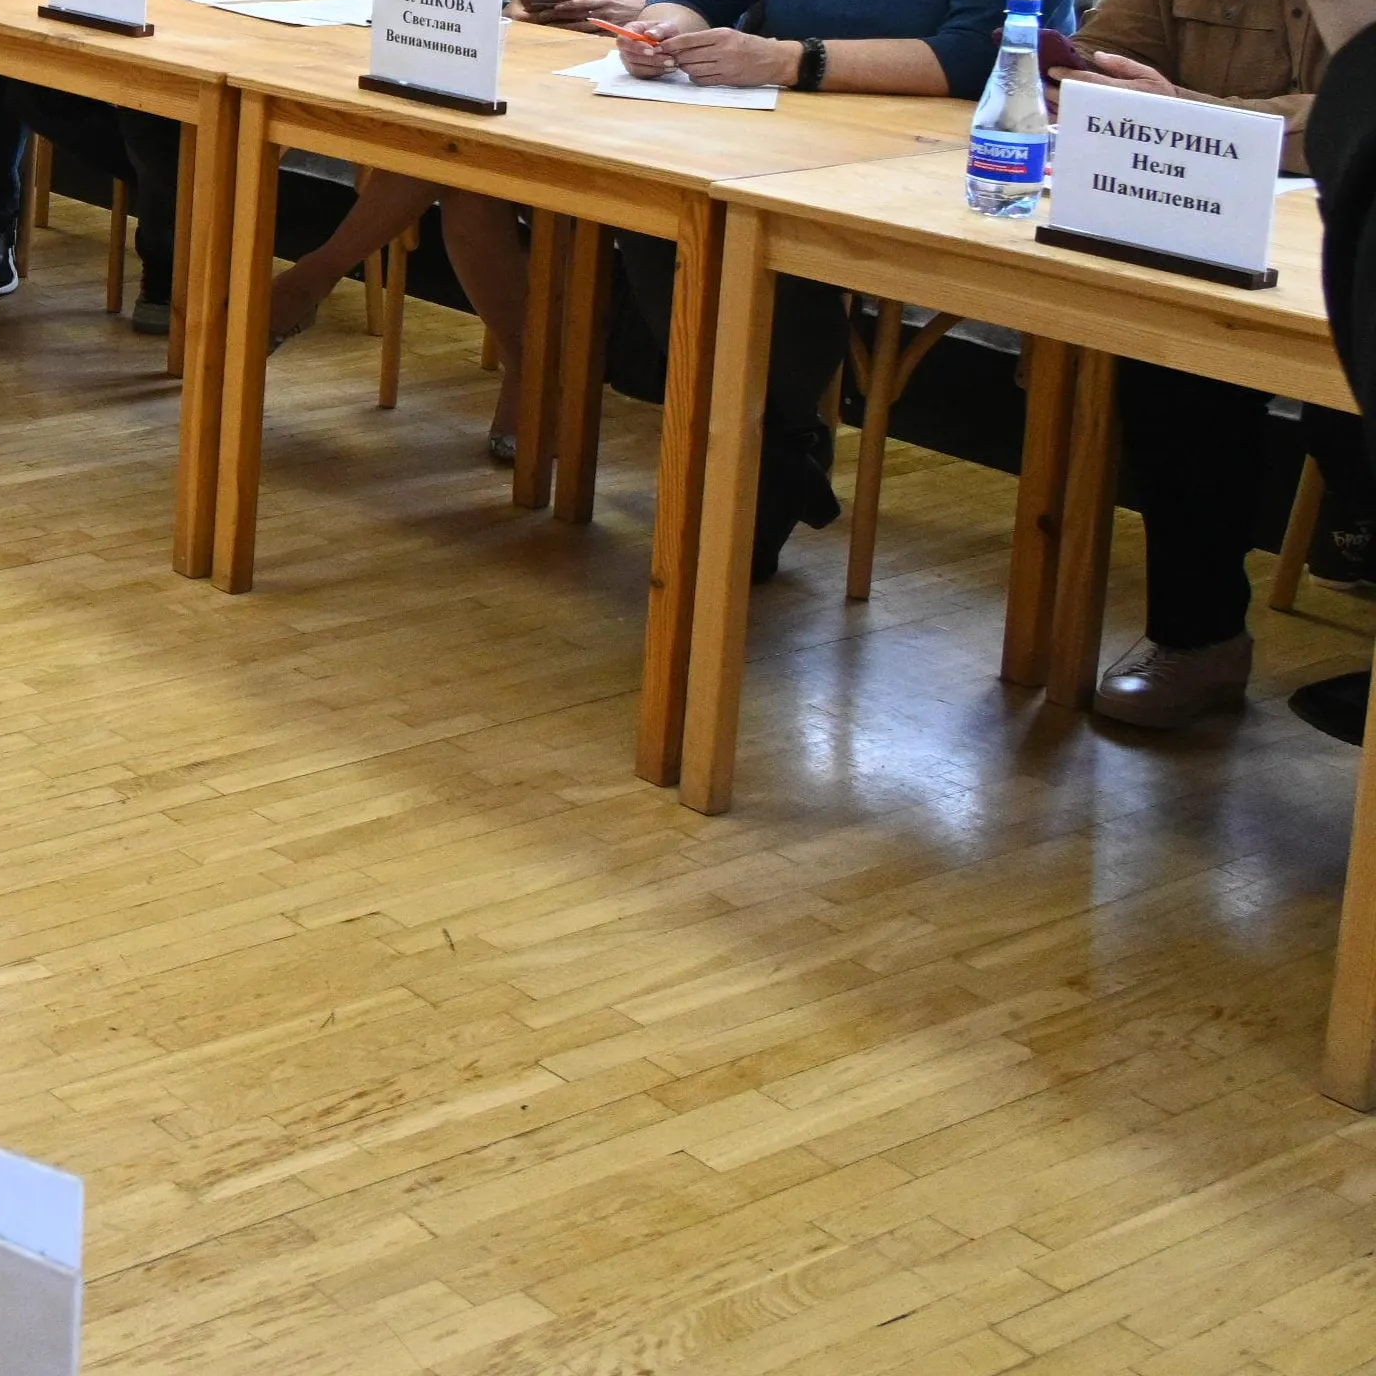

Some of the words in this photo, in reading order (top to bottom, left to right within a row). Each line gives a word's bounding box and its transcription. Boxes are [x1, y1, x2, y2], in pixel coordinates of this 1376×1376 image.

[403, 10, 462, 34] Светлана
[386, 28, 478, 59] Вениаминовна
[1087, 114, 1241, 160] БАЙБУРИНА
[1131, 152, 1186, 179] Неля
[1091, 173, 1222, 216] Шамилевна
